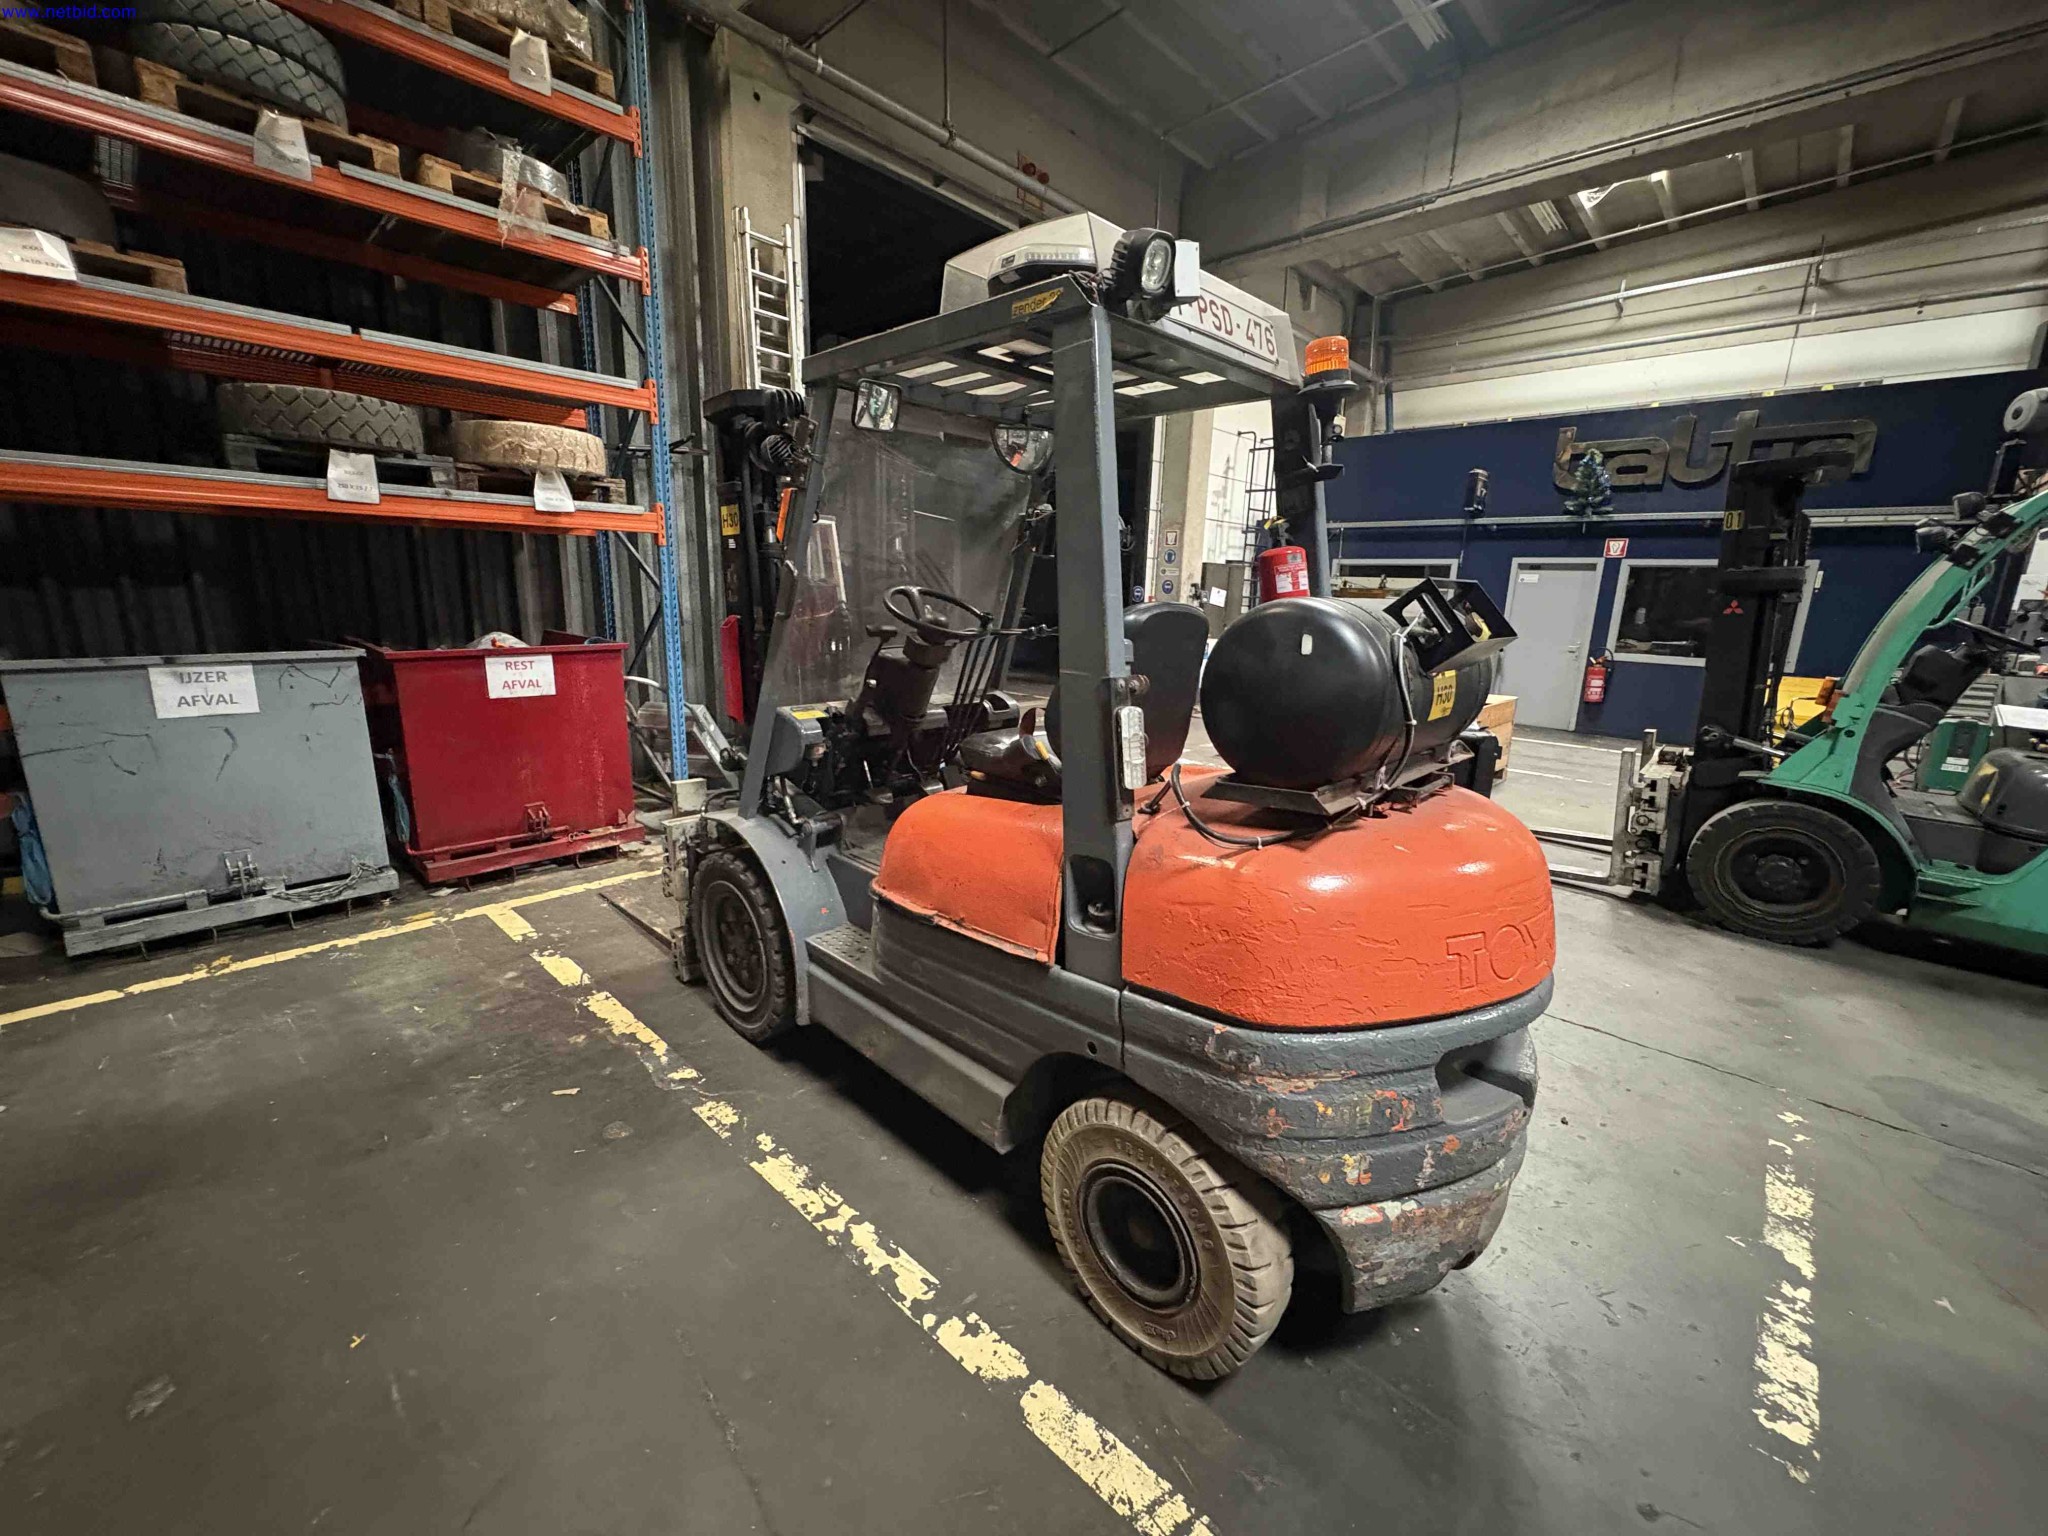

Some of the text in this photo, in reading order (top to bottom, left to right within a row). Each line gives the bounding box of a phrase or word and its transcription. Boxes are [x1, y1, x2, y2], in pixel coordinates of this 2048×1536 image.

[722, 512, 739, 529] H30
[1725, 512, 1742, 529] 01
[505, 660, 535, 671] REST
[179, 671, 229, 684] IJZER
[502, 679, 542, 690] AFVAL
[177, 693, 240, 708] AFVAL
